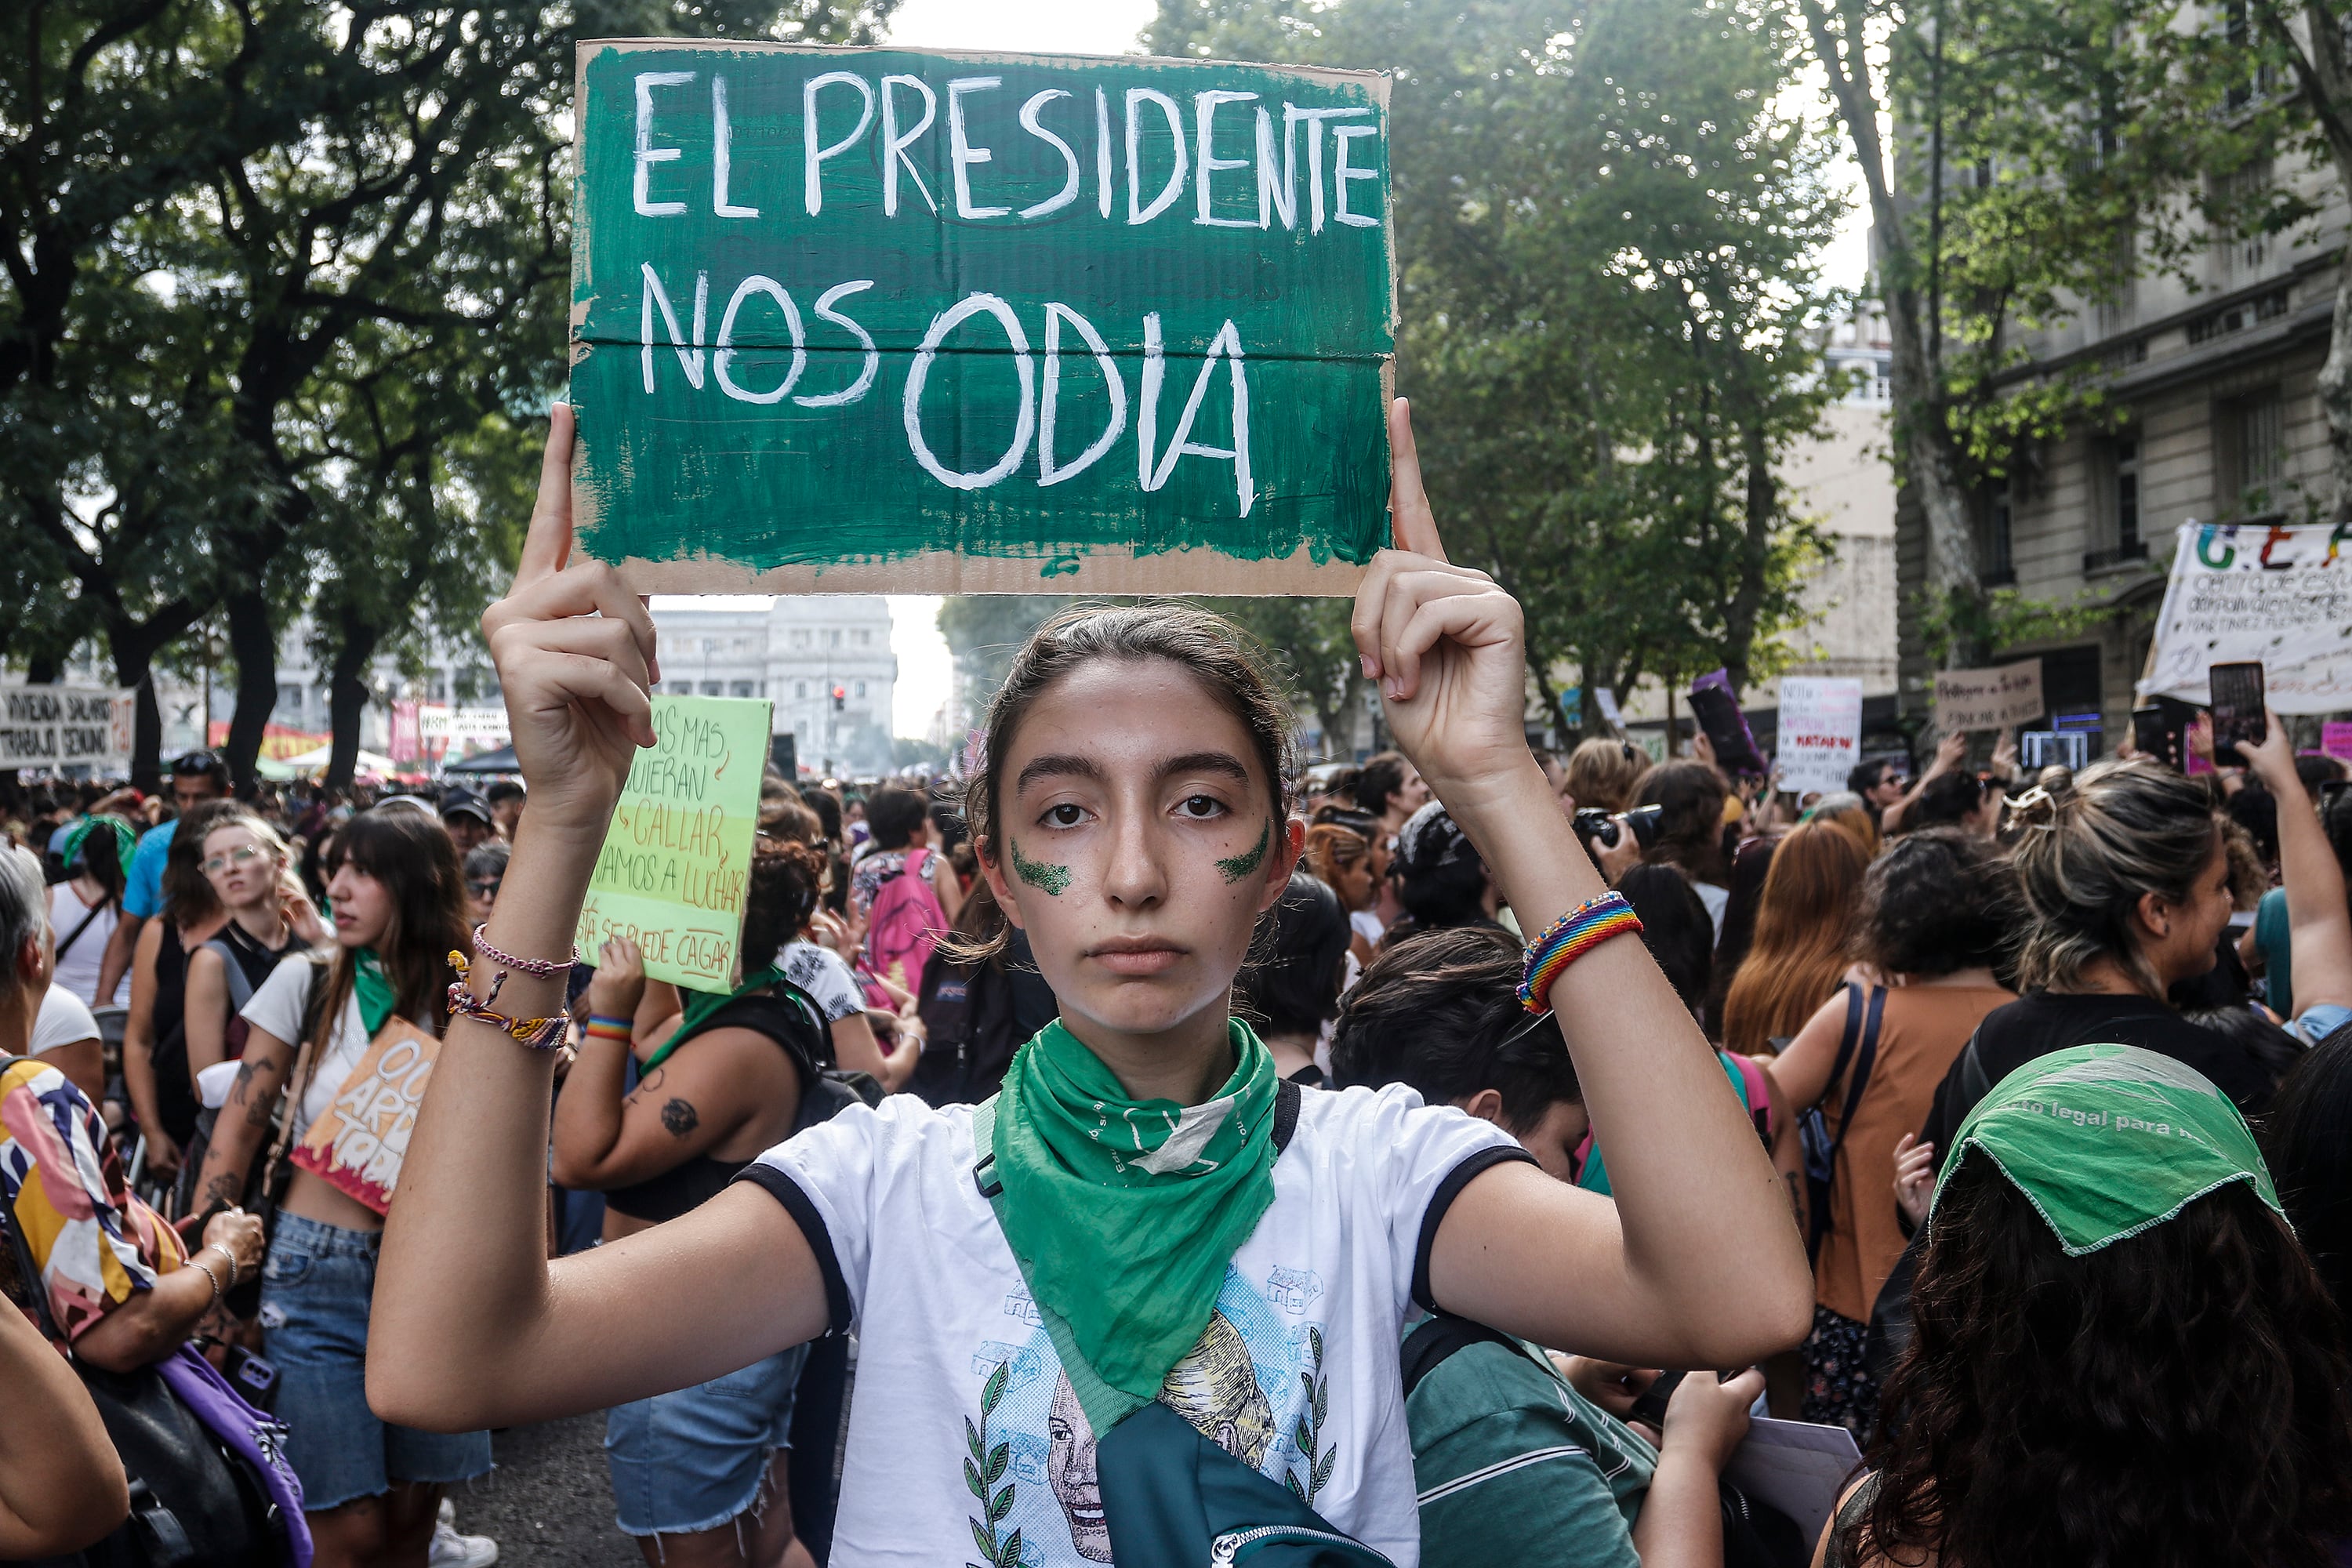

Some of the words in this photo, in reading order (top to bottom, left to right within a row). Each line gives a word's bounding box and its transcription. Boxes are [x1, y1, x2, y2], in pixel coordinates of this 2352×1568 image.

[633, 71, 760, 219] EL
[804, 71, 1380, 236] PRESIDENTE
[641, 261, 880, 408] NOS
[904, 291, 1260, 519] ODIA
[681, 717, 724, 759] MAS
[633, 798, 724, 858] CALLAR
[660, 858, 677, 892] A
[682, 861, 746, 918] LUCHAR
[677, 935, 731, 980] CAGAR
[334, 1075, 419, 1156] ARD
[2051, 1102, 2108, 1127] legal
[2116, 1116, 2171, 1135] para
